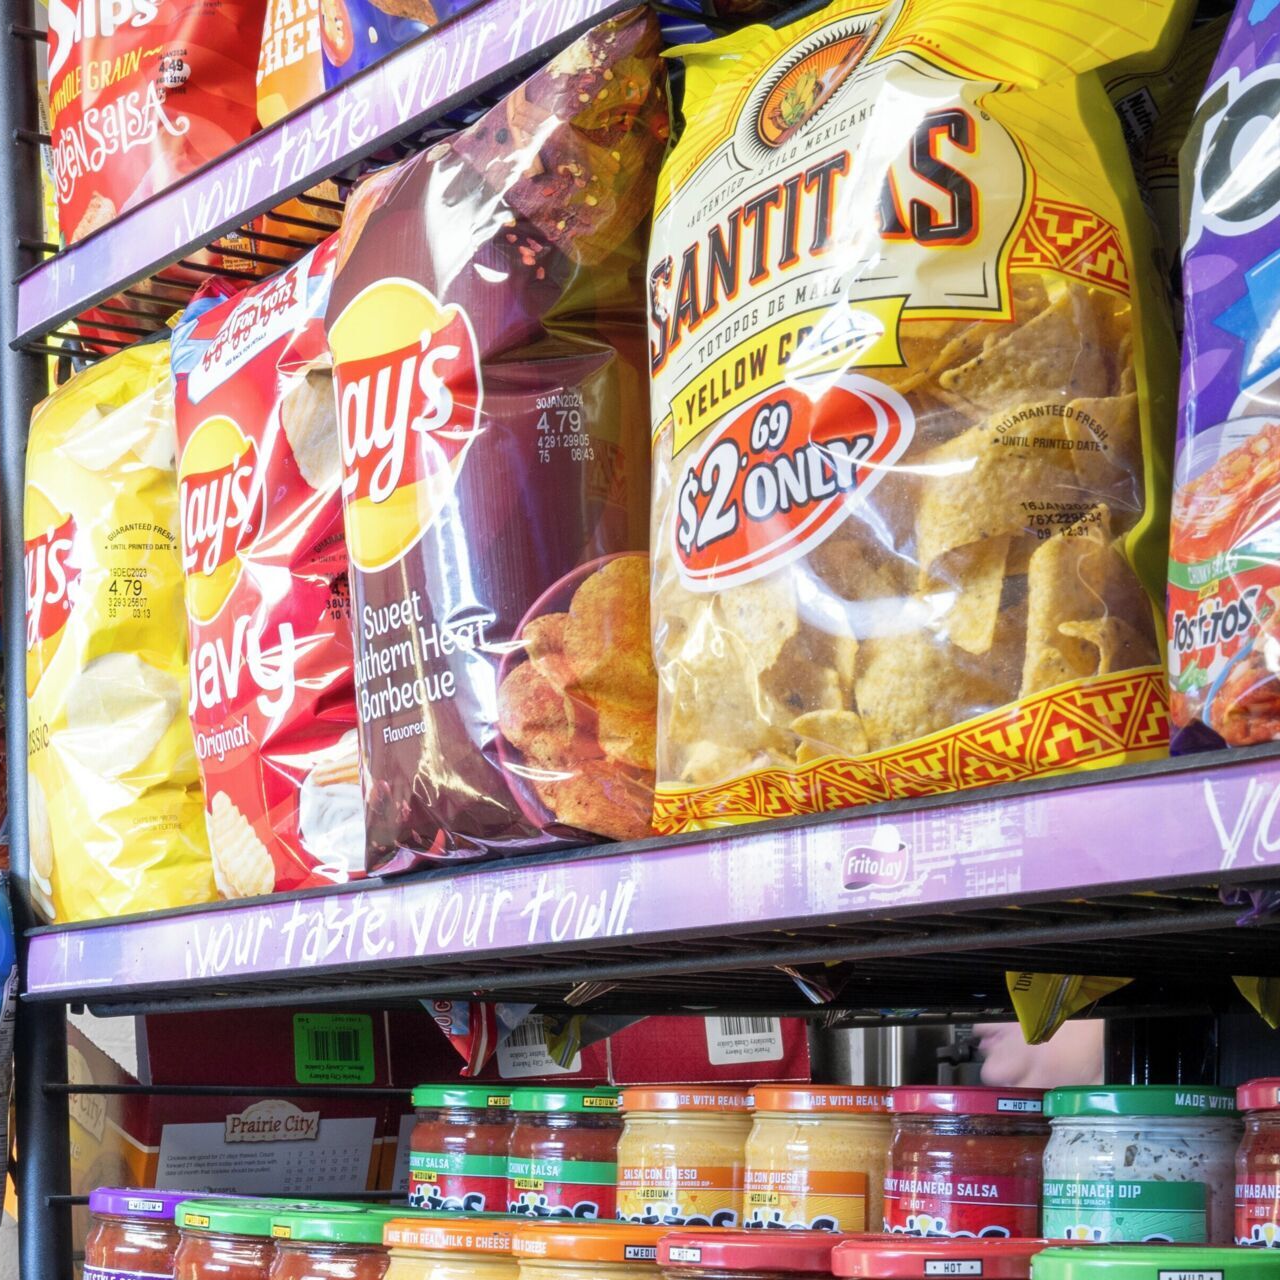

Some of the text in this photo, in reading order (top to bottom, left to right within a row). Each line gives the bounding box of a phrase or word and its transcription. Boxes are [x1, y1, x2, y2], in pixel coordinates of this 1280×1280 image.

[87, 51, 142, 89] GRAIN
[176, 22, 496, 247] your taste. your
[698, 293, 787, 364] TOTOPOS DE
[686, 343, 768, 426] YELLOW
[536, 395, 584, 410] 30JAN2024
[536, 411, 582, 435] 4.79
[996, 404, 1109, 441] GUARANTEED FRESH
[1002, 436, 1101, 452] UNTIL PRINTED DATE
[744, 436, 873, 522] ONLY
[107, 522, 176, 543] GUARANTEED FRESH
[126, 543, 153, 552] PRINTED
[108, 579, 144, 597] 4.79
[362, 590, 424, 641] Sweet
[359, 670, 456, 724] Barbecue
[197, 715, 251, 762] Original
[383, 720, 429, 744] Flavored
[184, 877, 636, 979] your taste. your town.
[830, 1095, 879, 1107] WITH REAL
[1176, 1094, 1205, 1107] MADE
[230, 1116, 281, 1136] Prairie
[531, 1164, 559, 1176] SALSA
[900, 1180, 998, 1198] HABANERO SALSA
[1066, 1184, 1142, 1199] SPINACH DIP
[475, 1236, 510, 1250] CHEESE
